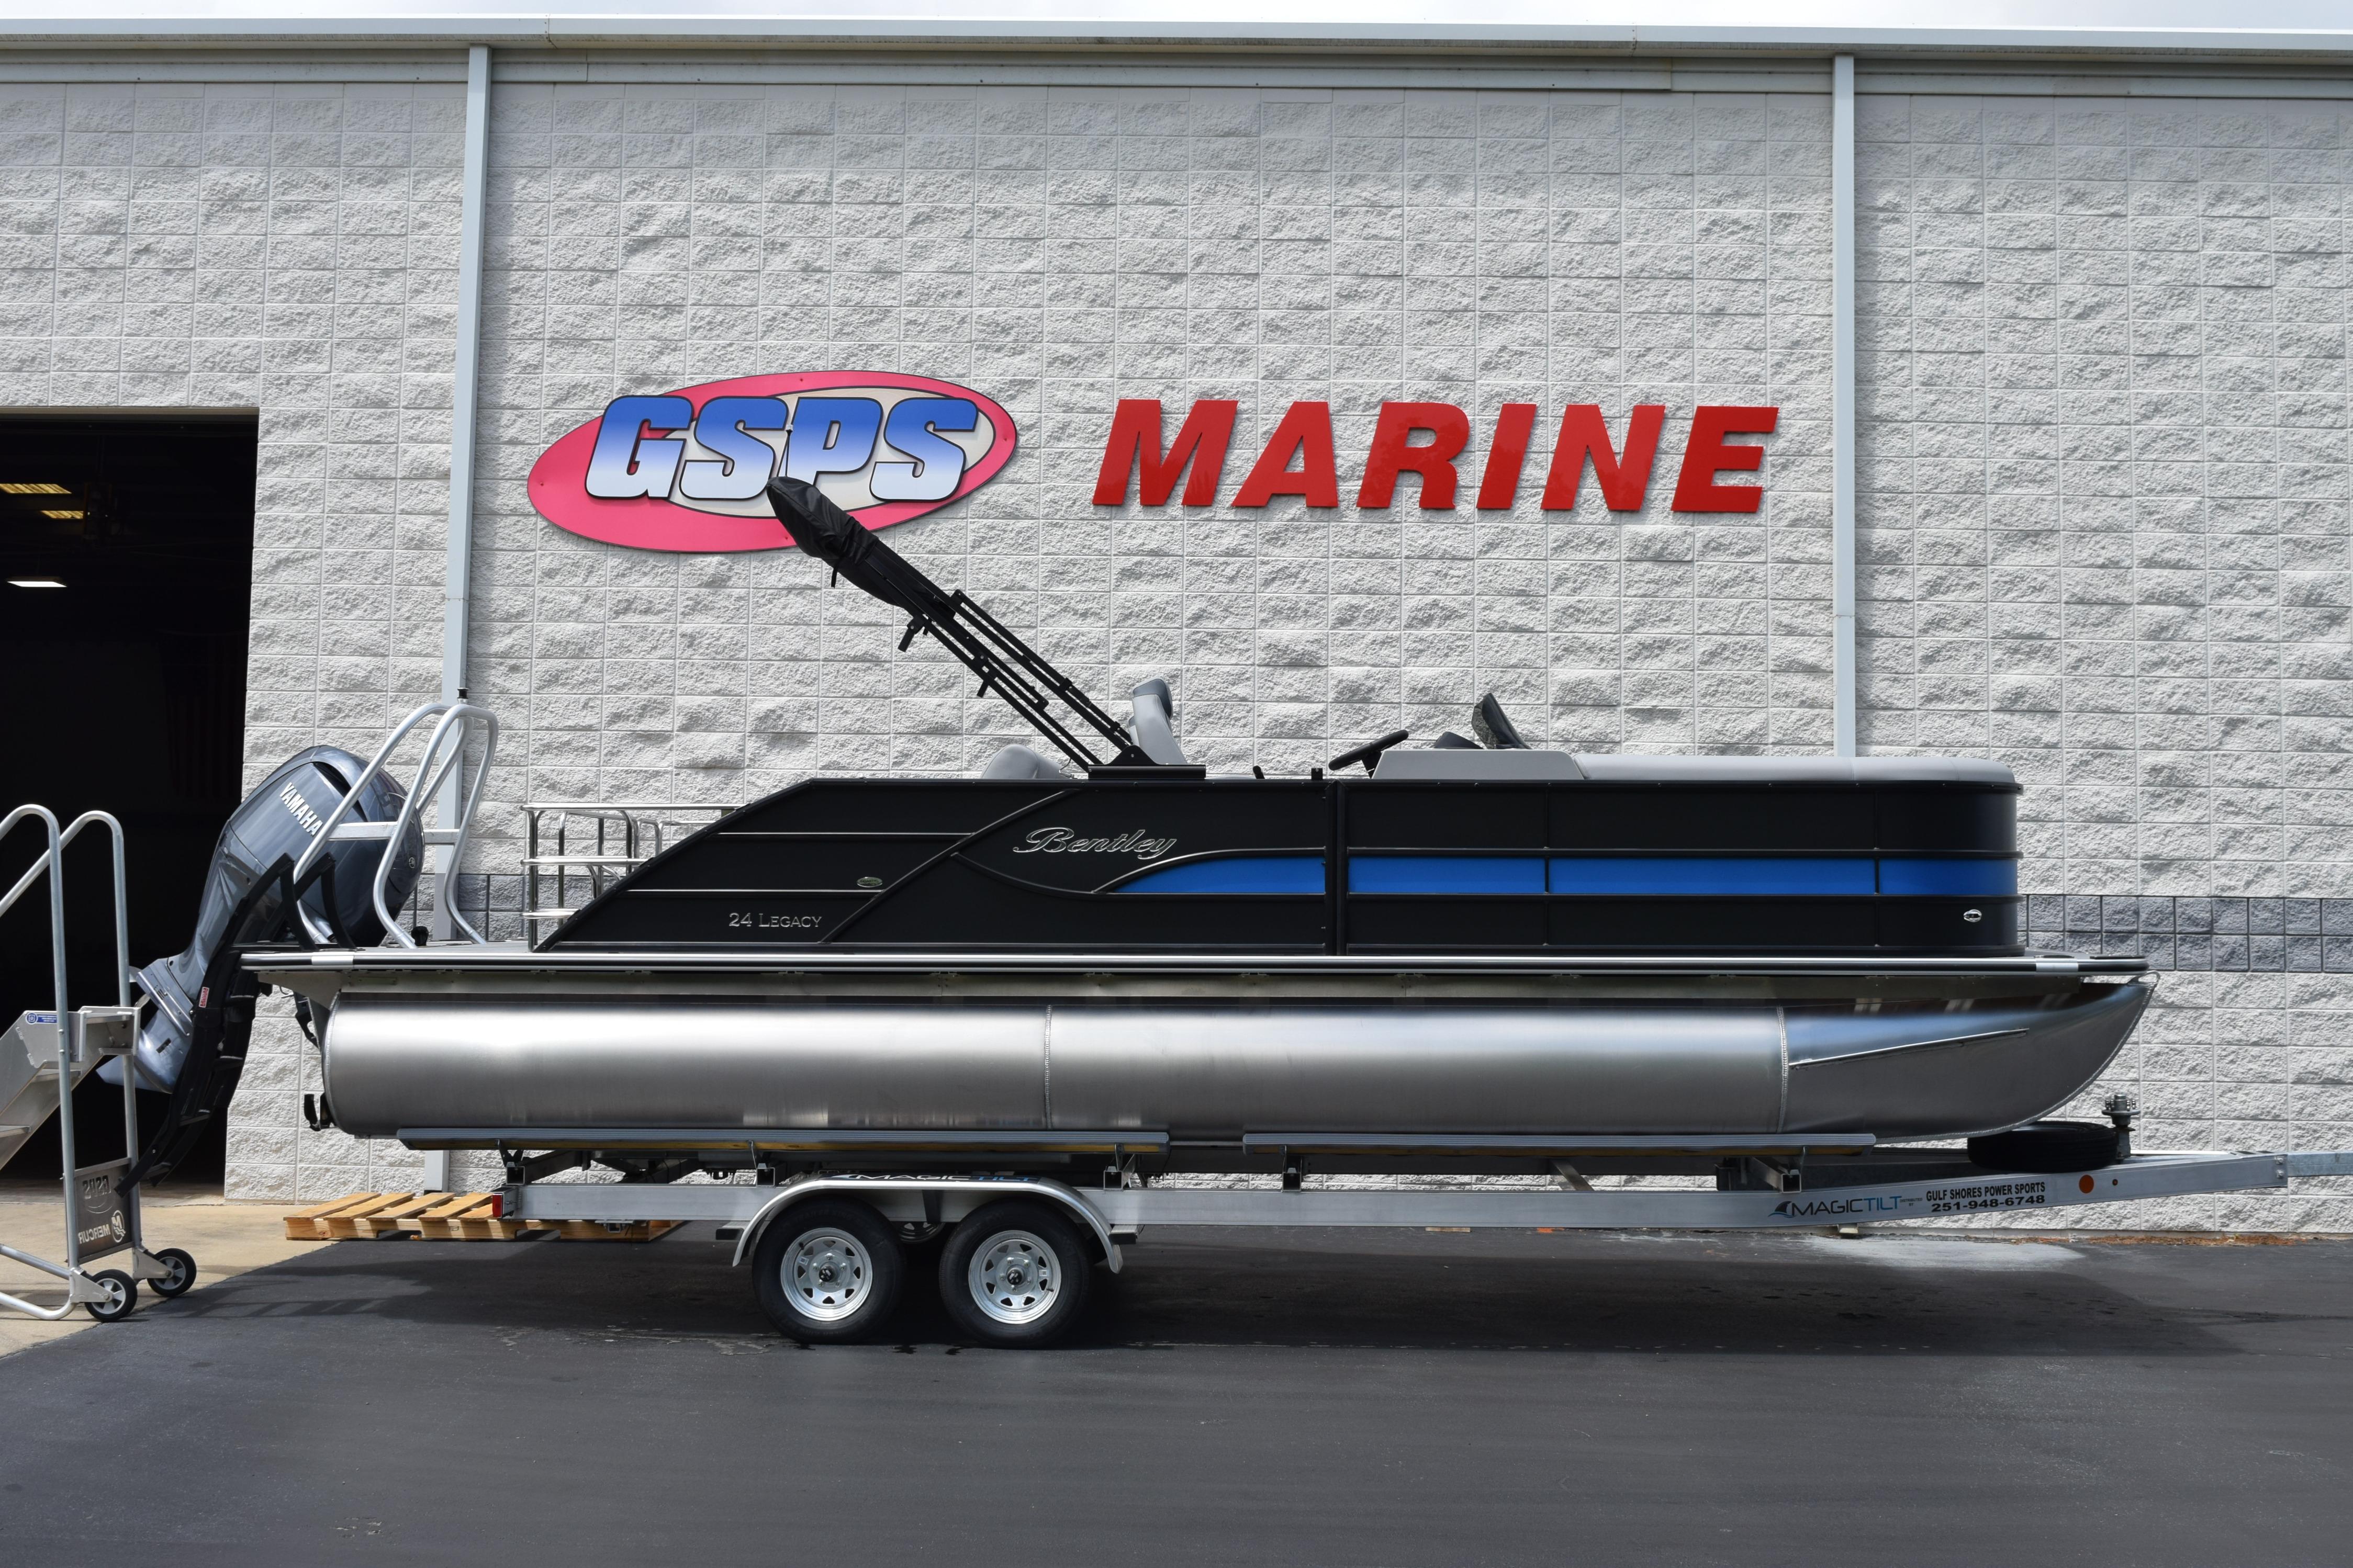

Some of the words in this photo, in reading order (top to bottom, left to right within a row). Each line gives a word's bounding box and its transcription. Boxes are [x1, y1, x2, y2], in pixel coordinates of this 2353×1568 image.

[585, 395, 979, 501] GSPS
[1092, 398, 1780, 513] MARINE
[279, 782, 323, 836] YAMAHA
[1013, 827, 1177, 860] Bentley
[729, 912, 752, 927] 24
[1926, 1190, 1947, 1202] GULF
[1949, 1187, 1982, 1200] SHORES
[1984, 1185, 2012, 1197] POWER
[2014, 1181, 2045, 1194] SPORTS
[1931, 1194, 2045, 1213] 251-948-6748
[1791, 1195, 1902, 1216] MAGICTILT
